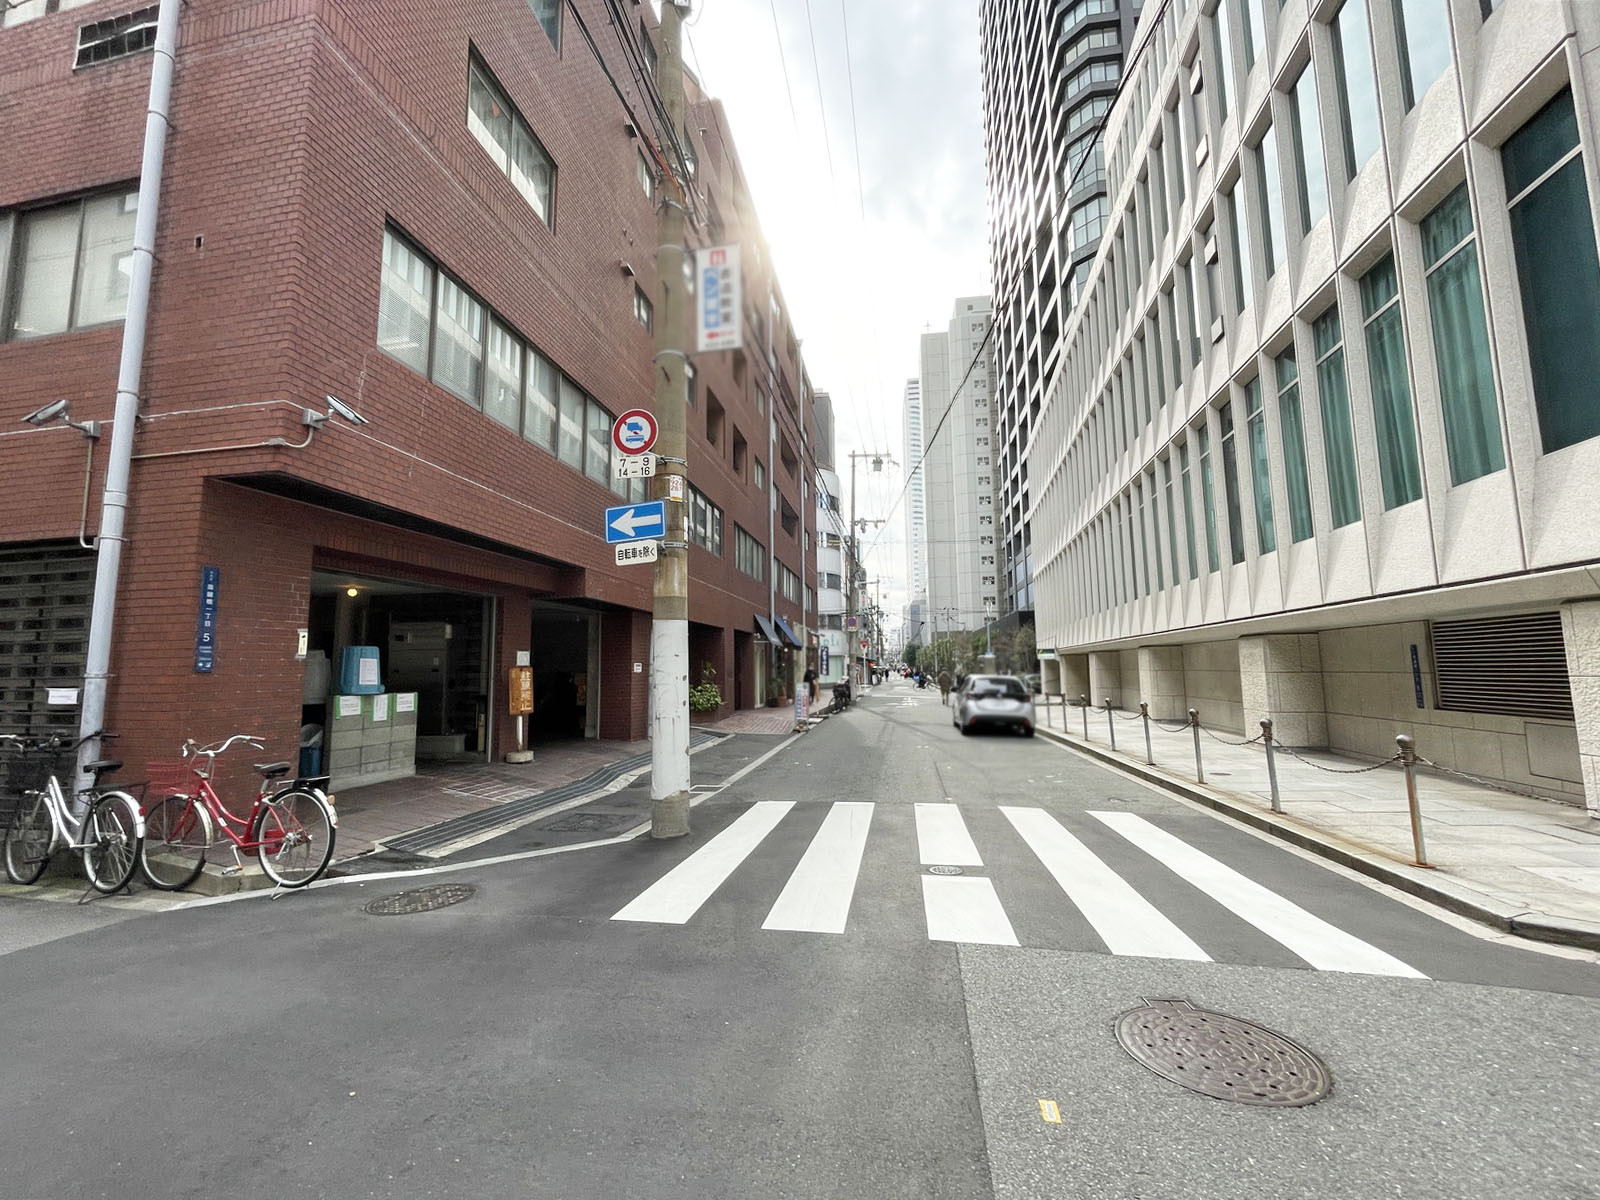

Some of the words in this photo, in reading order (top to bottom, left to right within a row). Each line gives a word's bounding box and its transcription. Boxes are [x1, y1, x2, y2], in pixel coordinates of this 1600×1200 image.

[620, 458, 627, 467] 7
[643, 456, 650, 466] 9
[618, 468, 628, 477] 14
[641, 467, 650, 476] 16
[617, 545, 655, 561] 自転車を除く
[202, 632, 211, 642] 5
